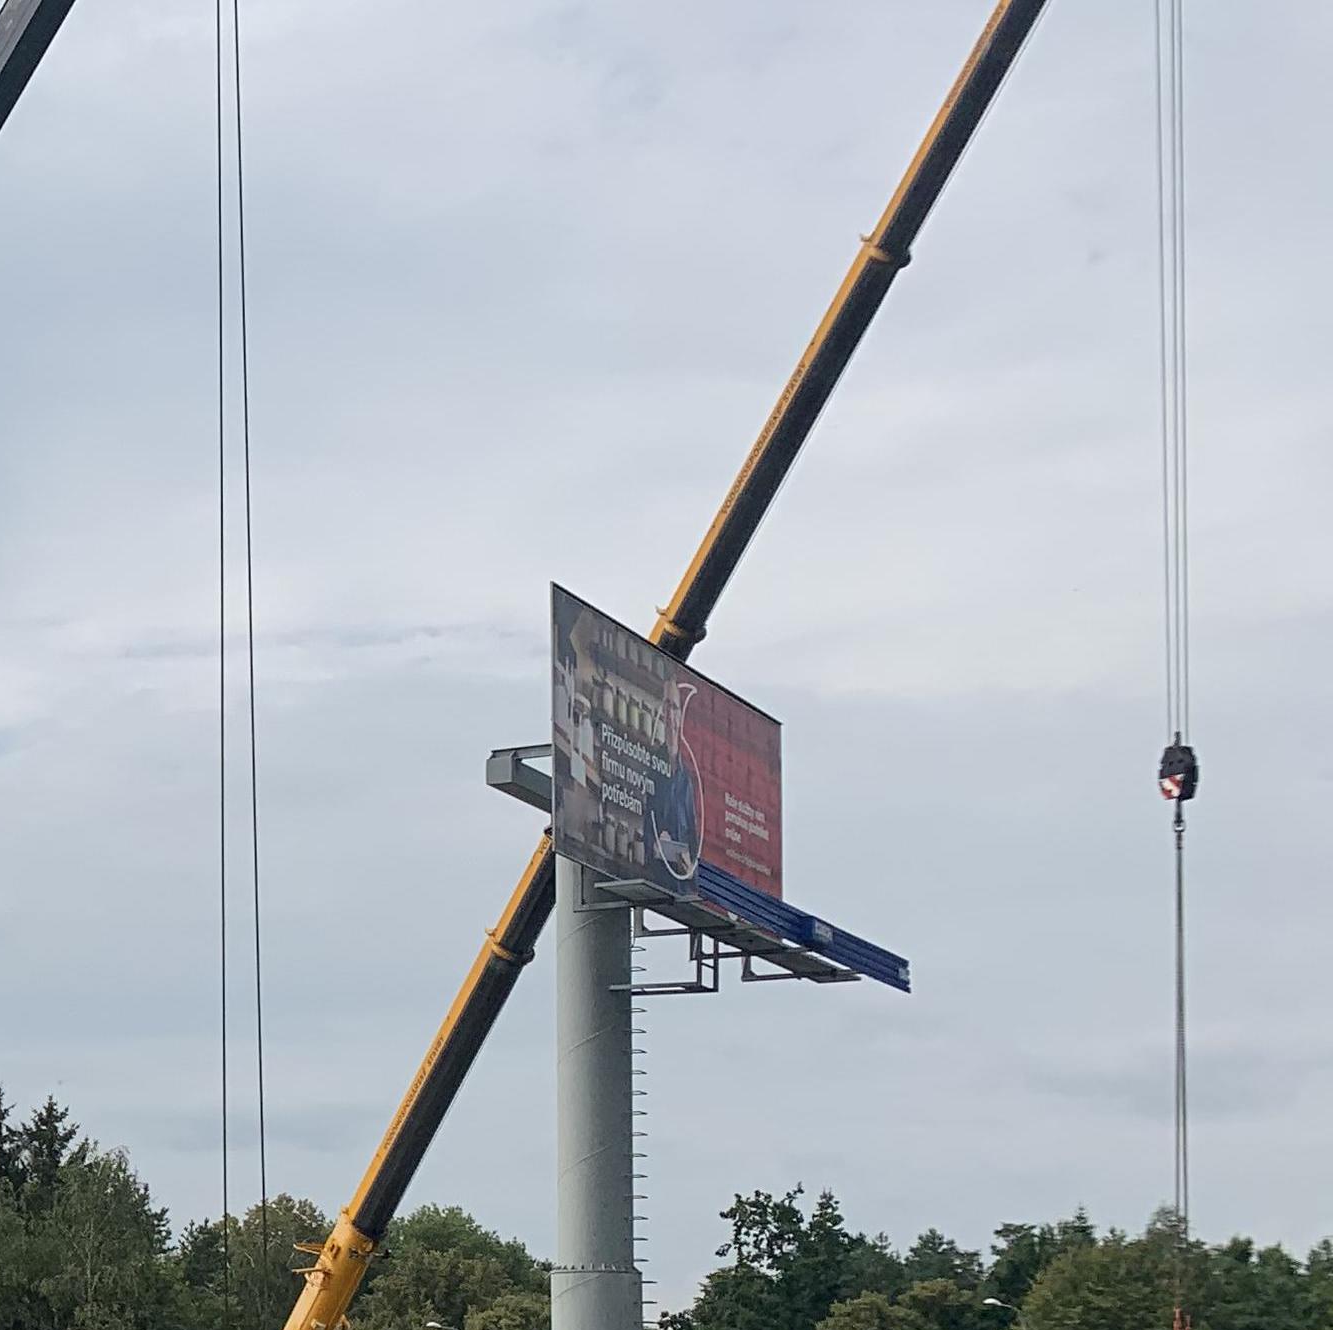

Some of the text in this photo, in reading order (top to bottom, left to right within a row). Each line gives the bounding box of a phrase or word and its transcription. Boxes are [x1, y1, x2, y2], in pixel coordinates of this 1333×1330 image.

[602, 750, 655, 796] firmu novým
[652, 755, 671, 778] svou
[602, 782, 642, 816] potřebám
